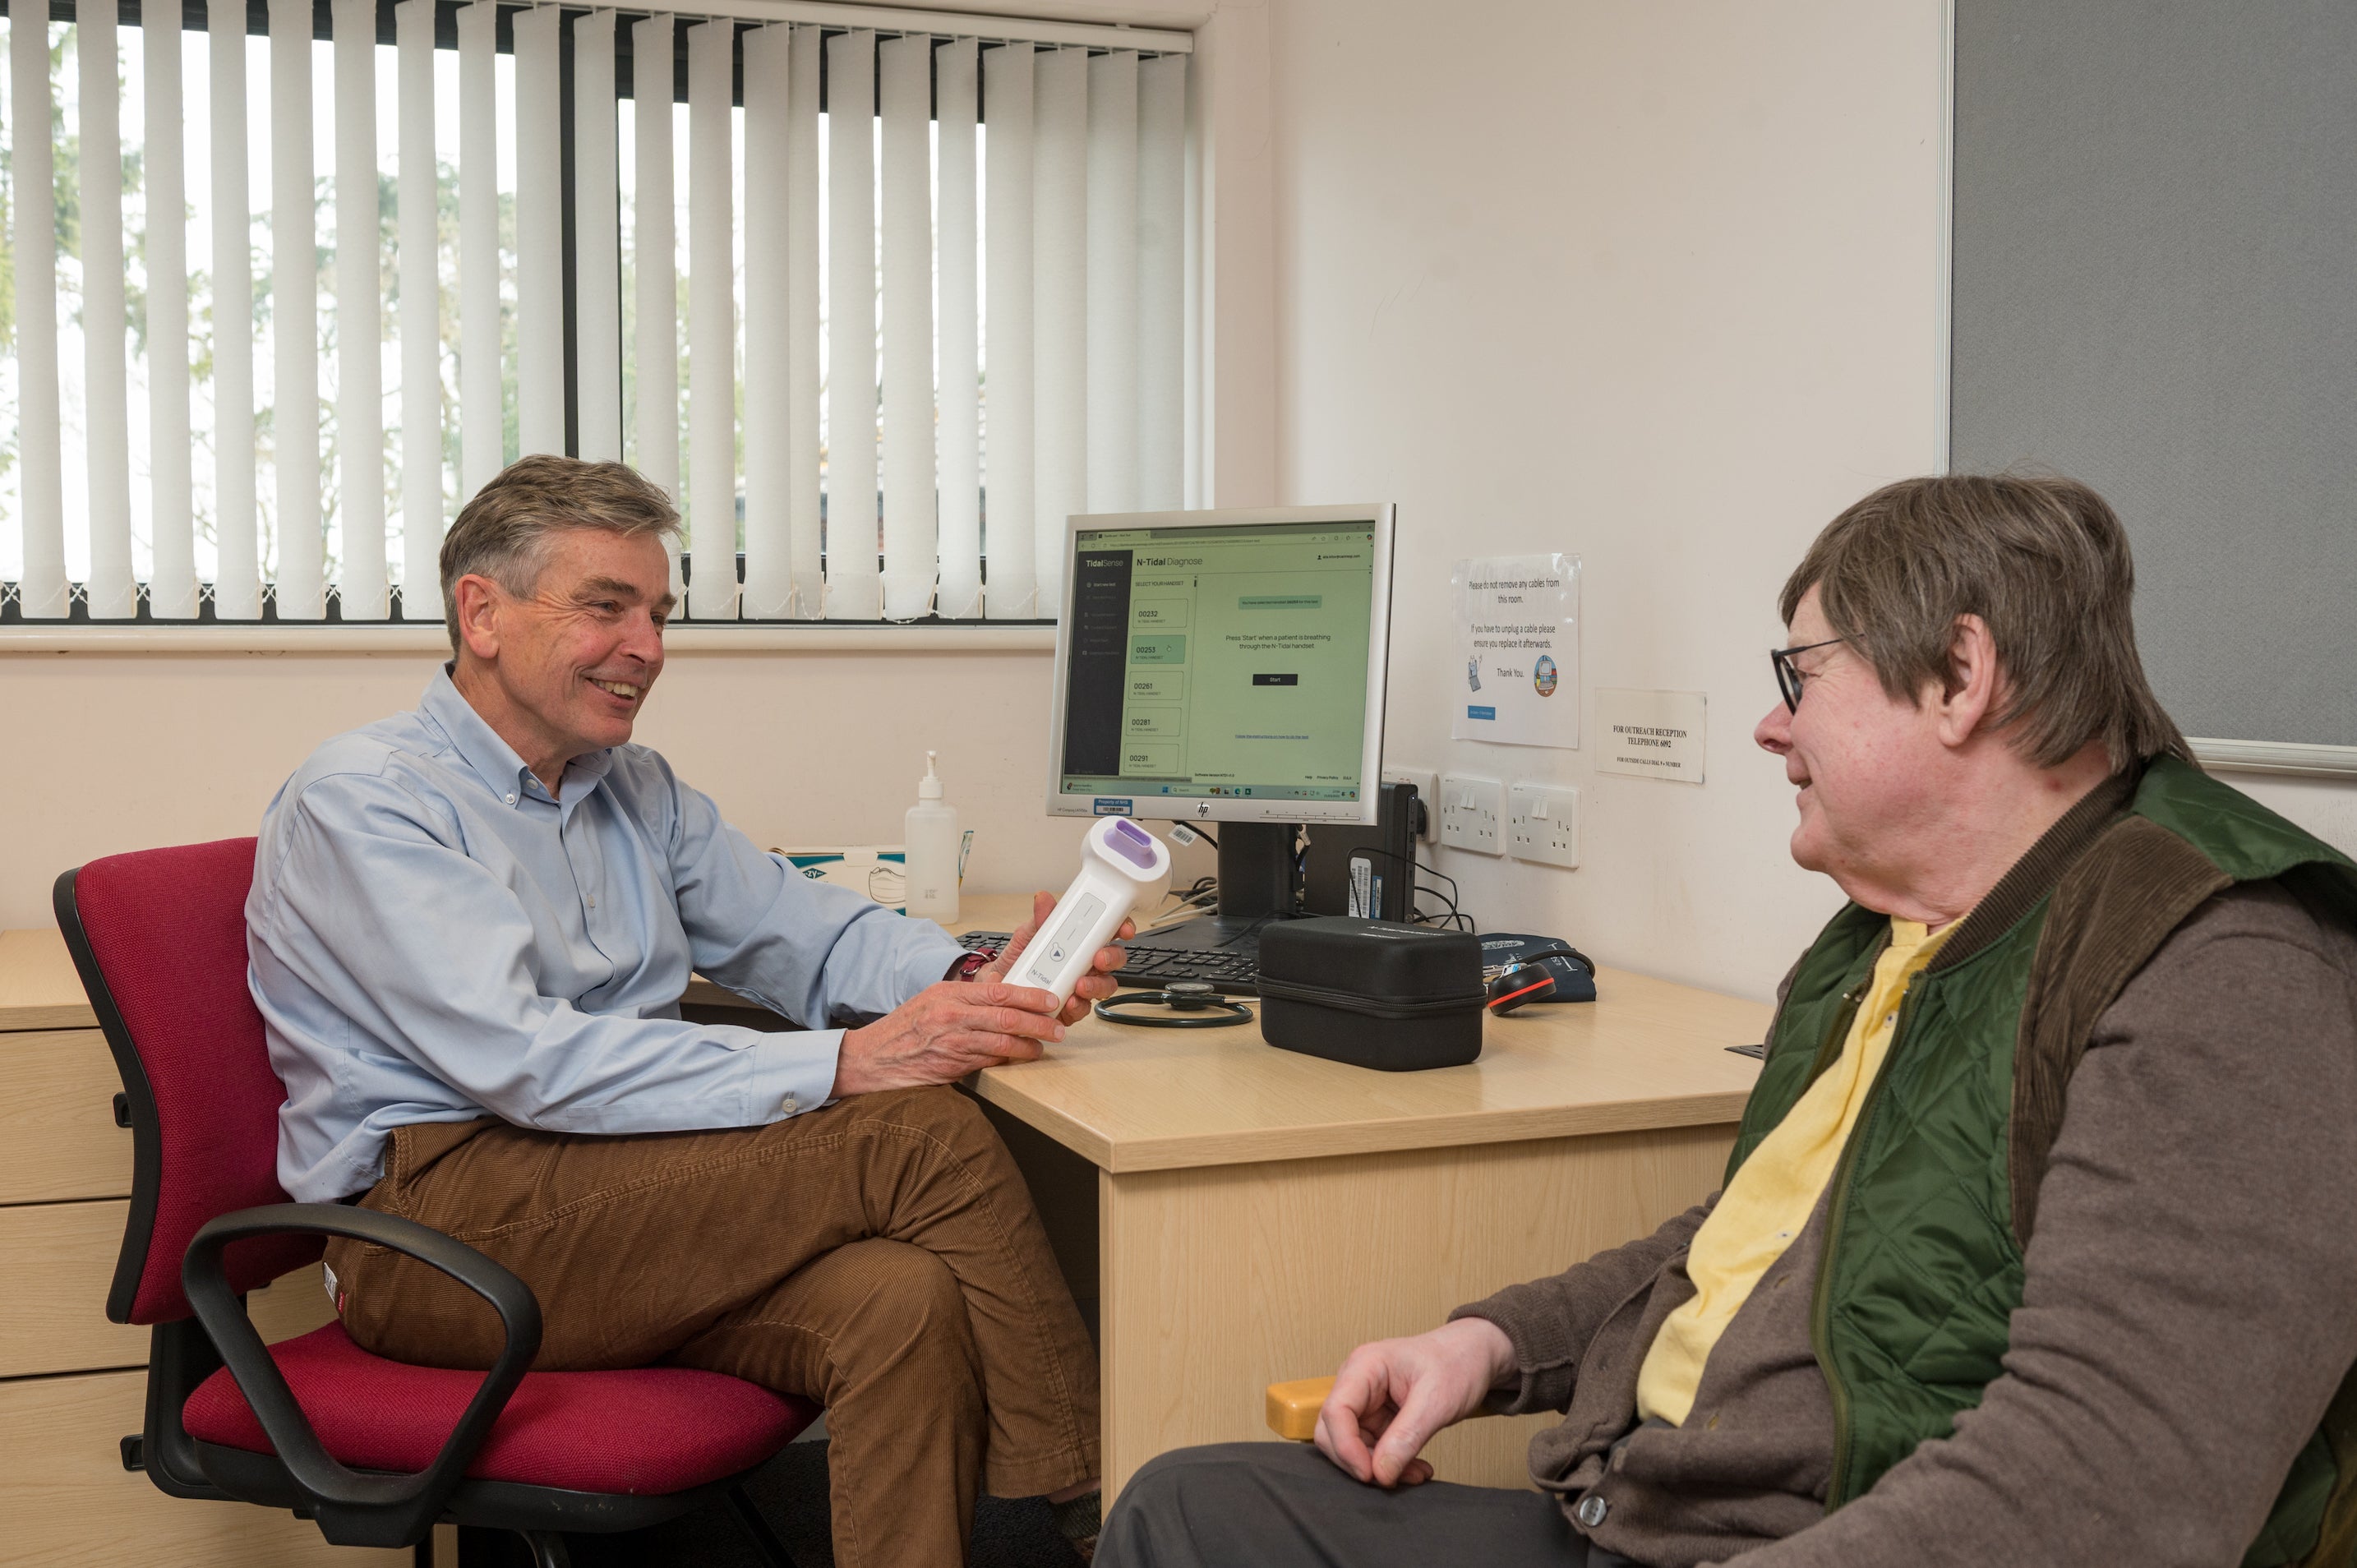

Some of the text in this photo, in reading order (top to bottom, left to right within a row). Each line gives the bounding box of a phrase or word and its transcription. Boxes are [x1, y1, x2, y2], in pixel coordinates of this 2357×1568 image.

[1086, 559, 1123, 567] TidalSense
[1137, 557, 1202, 568] N-Tidal Diagnose
[1469, 580, 1483, 589] Please
[1483, 580, 1488, 589] do
[1519, 582, 1527, 590] any
[1529, 579, 1545, 588] cables
[1546, 578, 1559, 588] from
[1498, 594, 1507, 603] this
[1471, 624, 1475, 633] If
[1475, 625, 1483, 634] you
[1484, 624, 1494, 633] have
[1496, 625, 1501, 633] to
[1501, 624, 1519, 634] unplug
[1524, 624, 1538, 633] cable
[1538, 624, 1555, 634] please
[1489, 640, 1497, 649] you
[1499, 639, 1517, 649] replace
[1519, 639, 1522, 648] it
[1523, 639, 1552, 648] afterwards.
[1497, 668, 1524, 677] Thank You.
[1613, 725, 1686, 738] FOR OUTREACH RECEPTION
[1627, 737, 1659, 746] TELEPHONE
[1198, 802, 1208, 817] hp
[1031, 969, 1052, 985] N-Tidal
